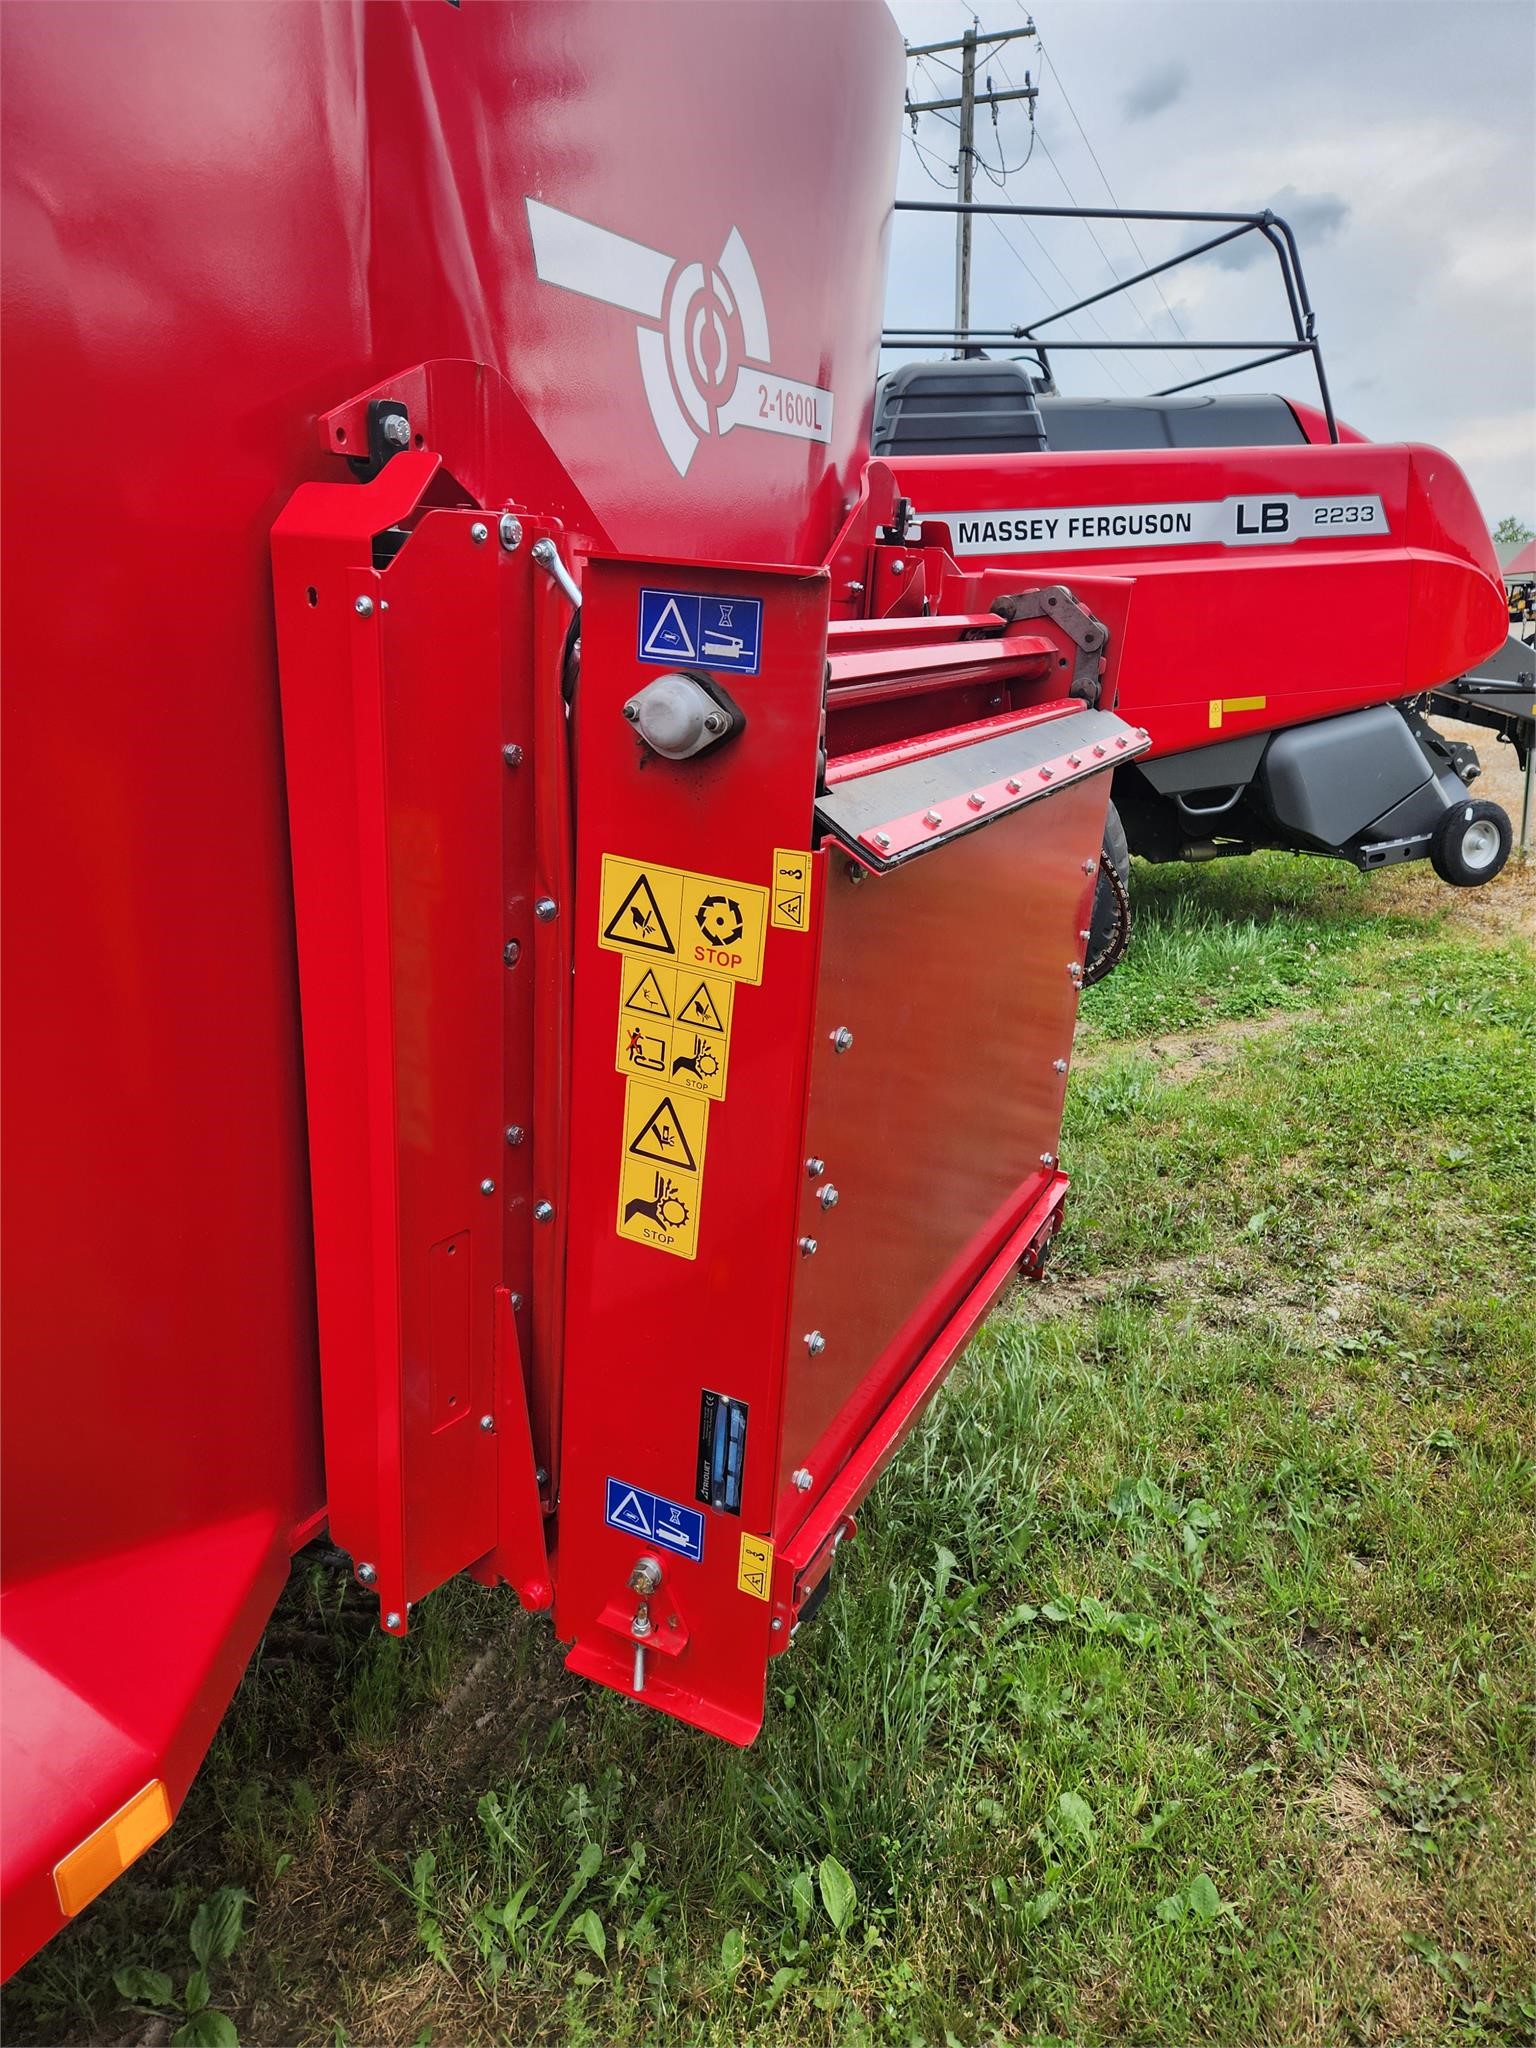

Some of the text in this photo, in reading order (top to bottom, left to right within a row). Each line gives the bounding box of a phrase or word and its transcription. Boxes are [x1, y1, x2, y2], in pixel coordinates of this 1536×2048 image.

[758, 384, 822, 431] 2-1600L
[958, 502, 1375, 544] MASSEY FERGUSON LB 2233
[694, 946, 742, 969] STOP
[685, 1078, 709, 1091] STOP
[643, 1228, 675, 1246] STOP
